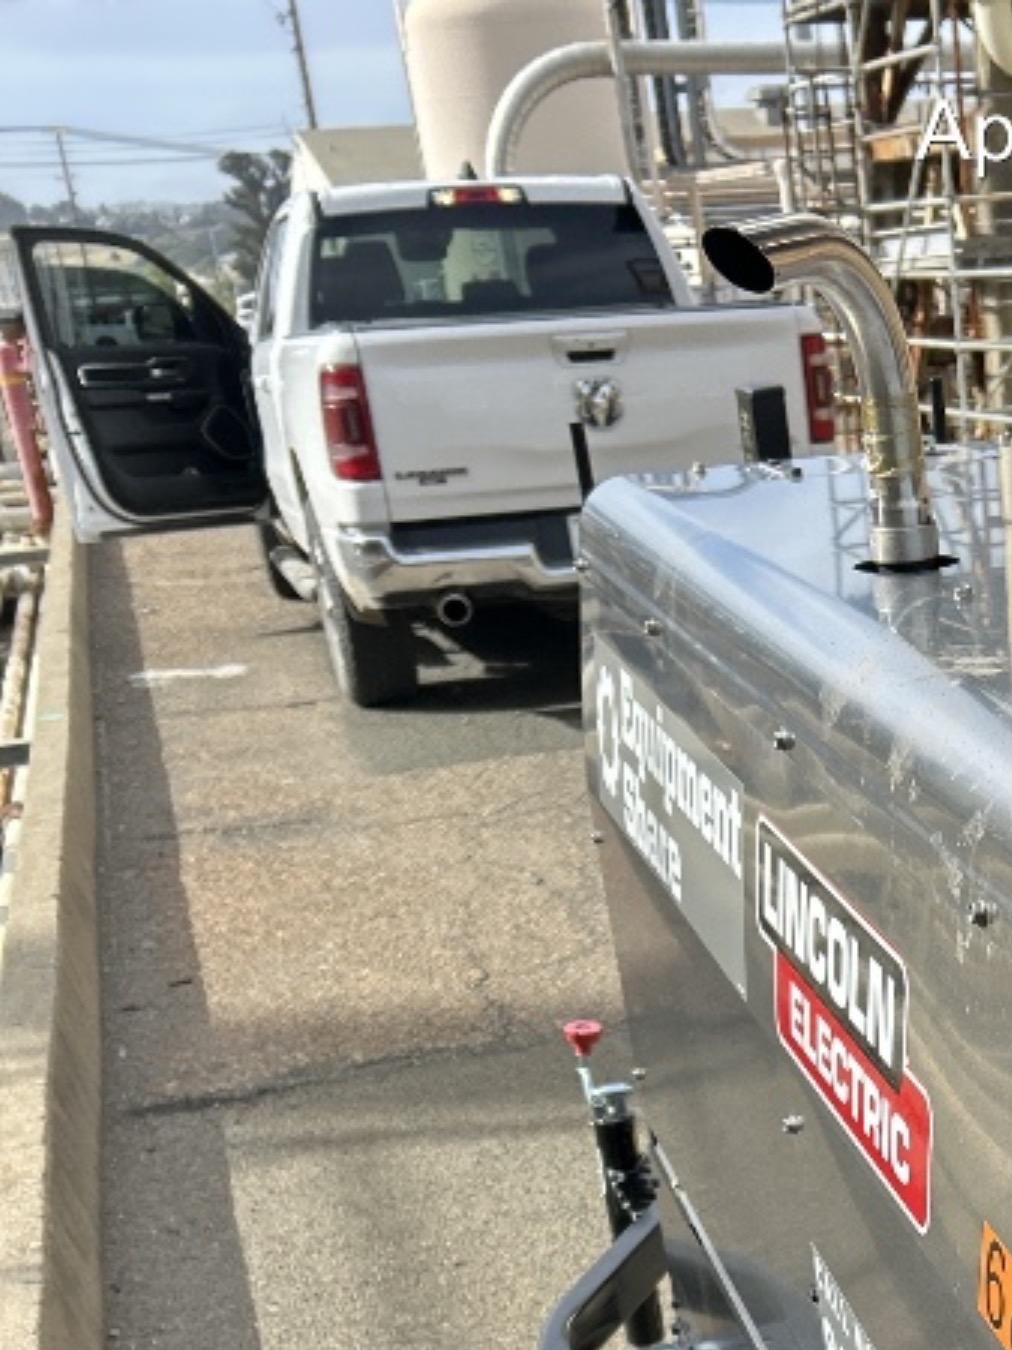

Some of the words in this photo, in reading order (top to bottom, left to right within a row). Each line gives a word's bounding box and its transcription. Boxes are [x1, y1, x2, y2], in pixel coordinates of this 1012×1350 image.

[620, 668, 742, 880] Equipment
[623, 760, 682, 903] Share
[763, 840, 896, 1068] LINCOLN
[789, 980, 911, 1186] ELECTRIC
